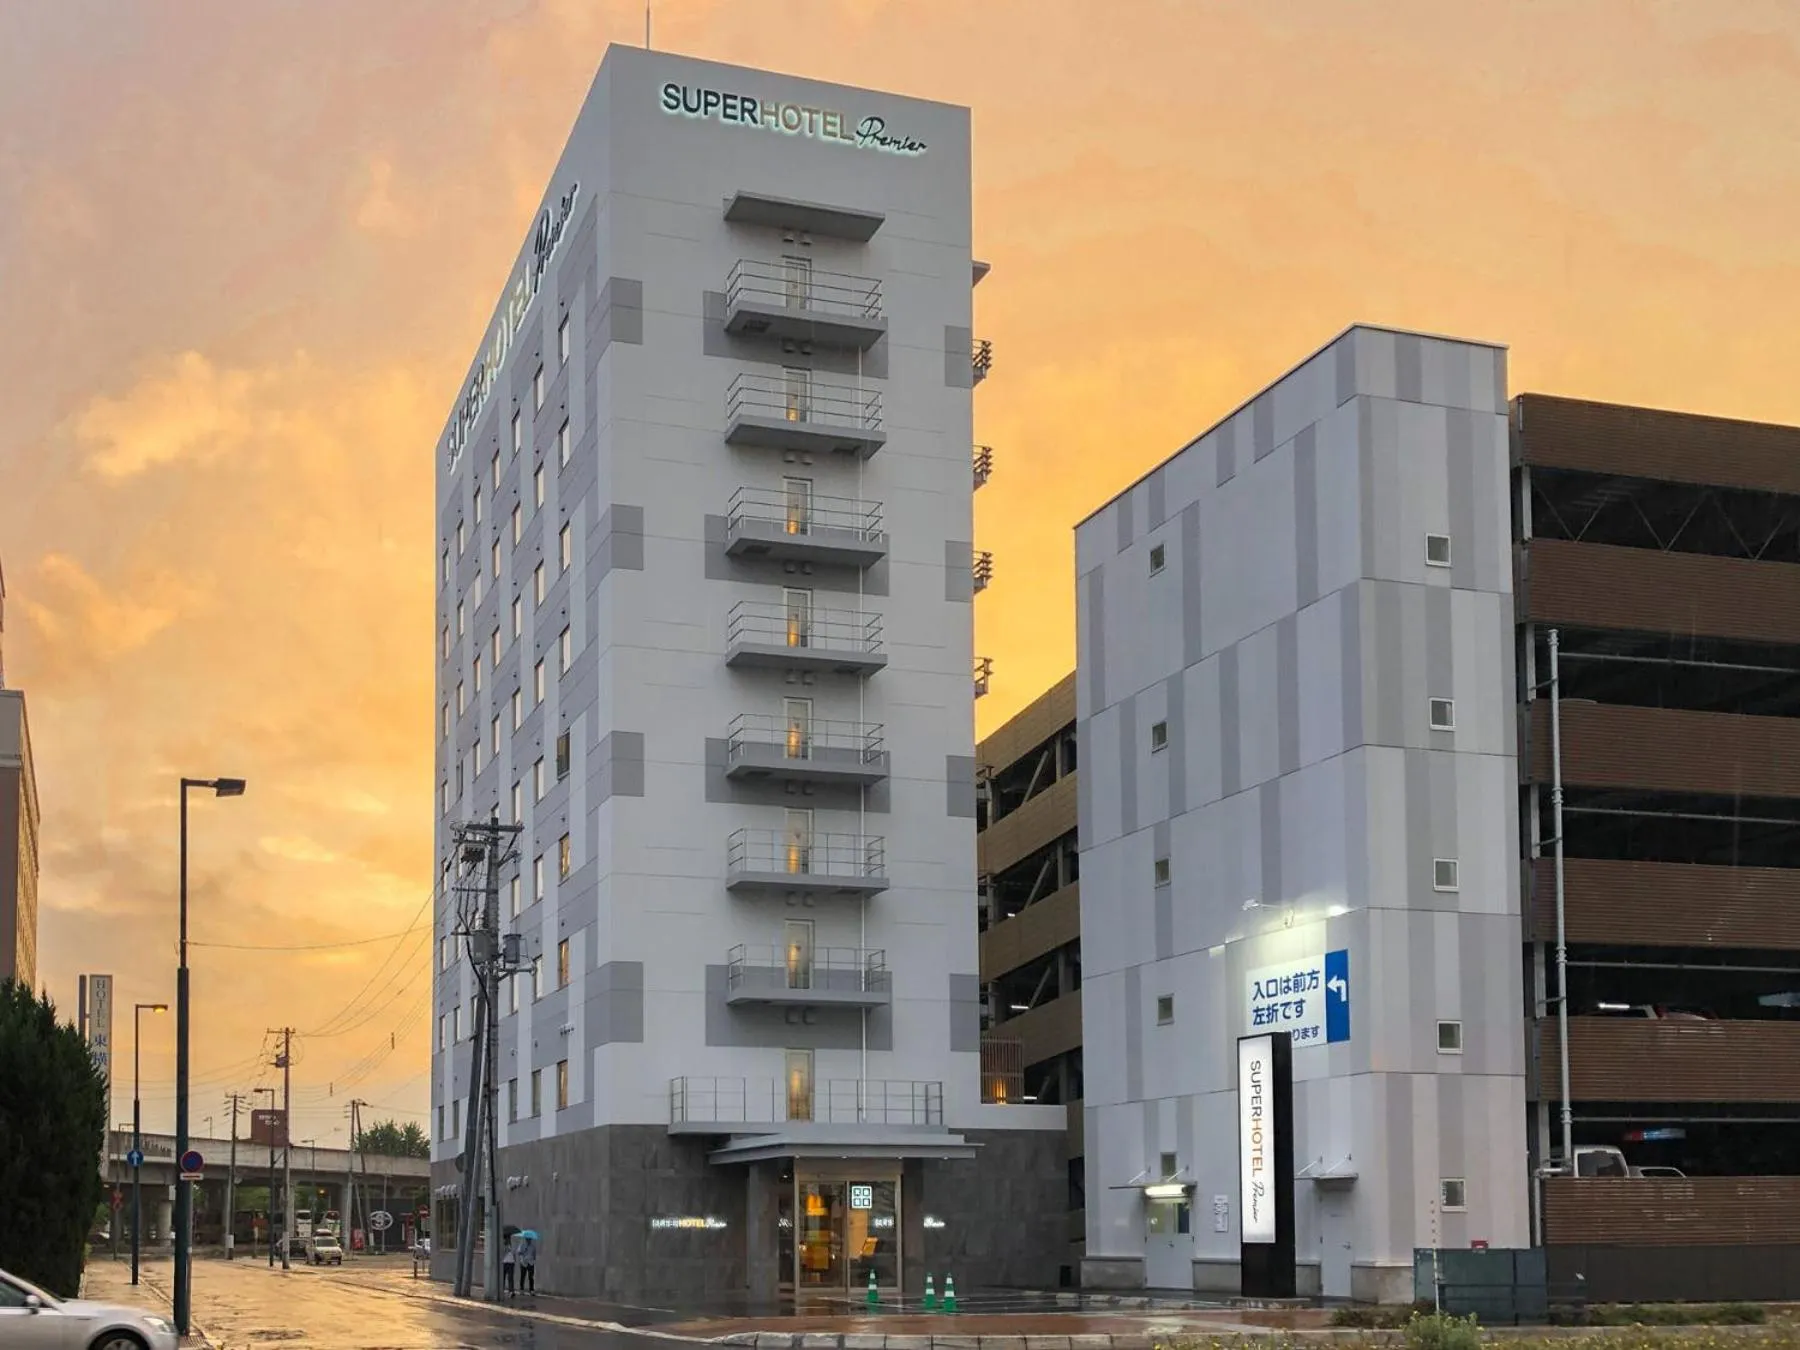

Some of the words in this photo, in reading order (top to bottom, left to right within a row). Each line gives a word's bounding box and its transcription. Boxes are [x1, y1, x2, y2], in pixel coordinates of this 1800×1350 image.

[662, 83, 854, 141] SUPERHOTEL
[856, 116, 927, 152] Premier
[1252, 969, 1320, 1001] 入口は前方
[1252, 998, 1306, 1026] 左折です
[1288, 1025, 1320, 1041] ります
[1250, 1060, 1264, 1178] SUPERHOTEL
[1252, 1181, 1265, 1224] Premier
